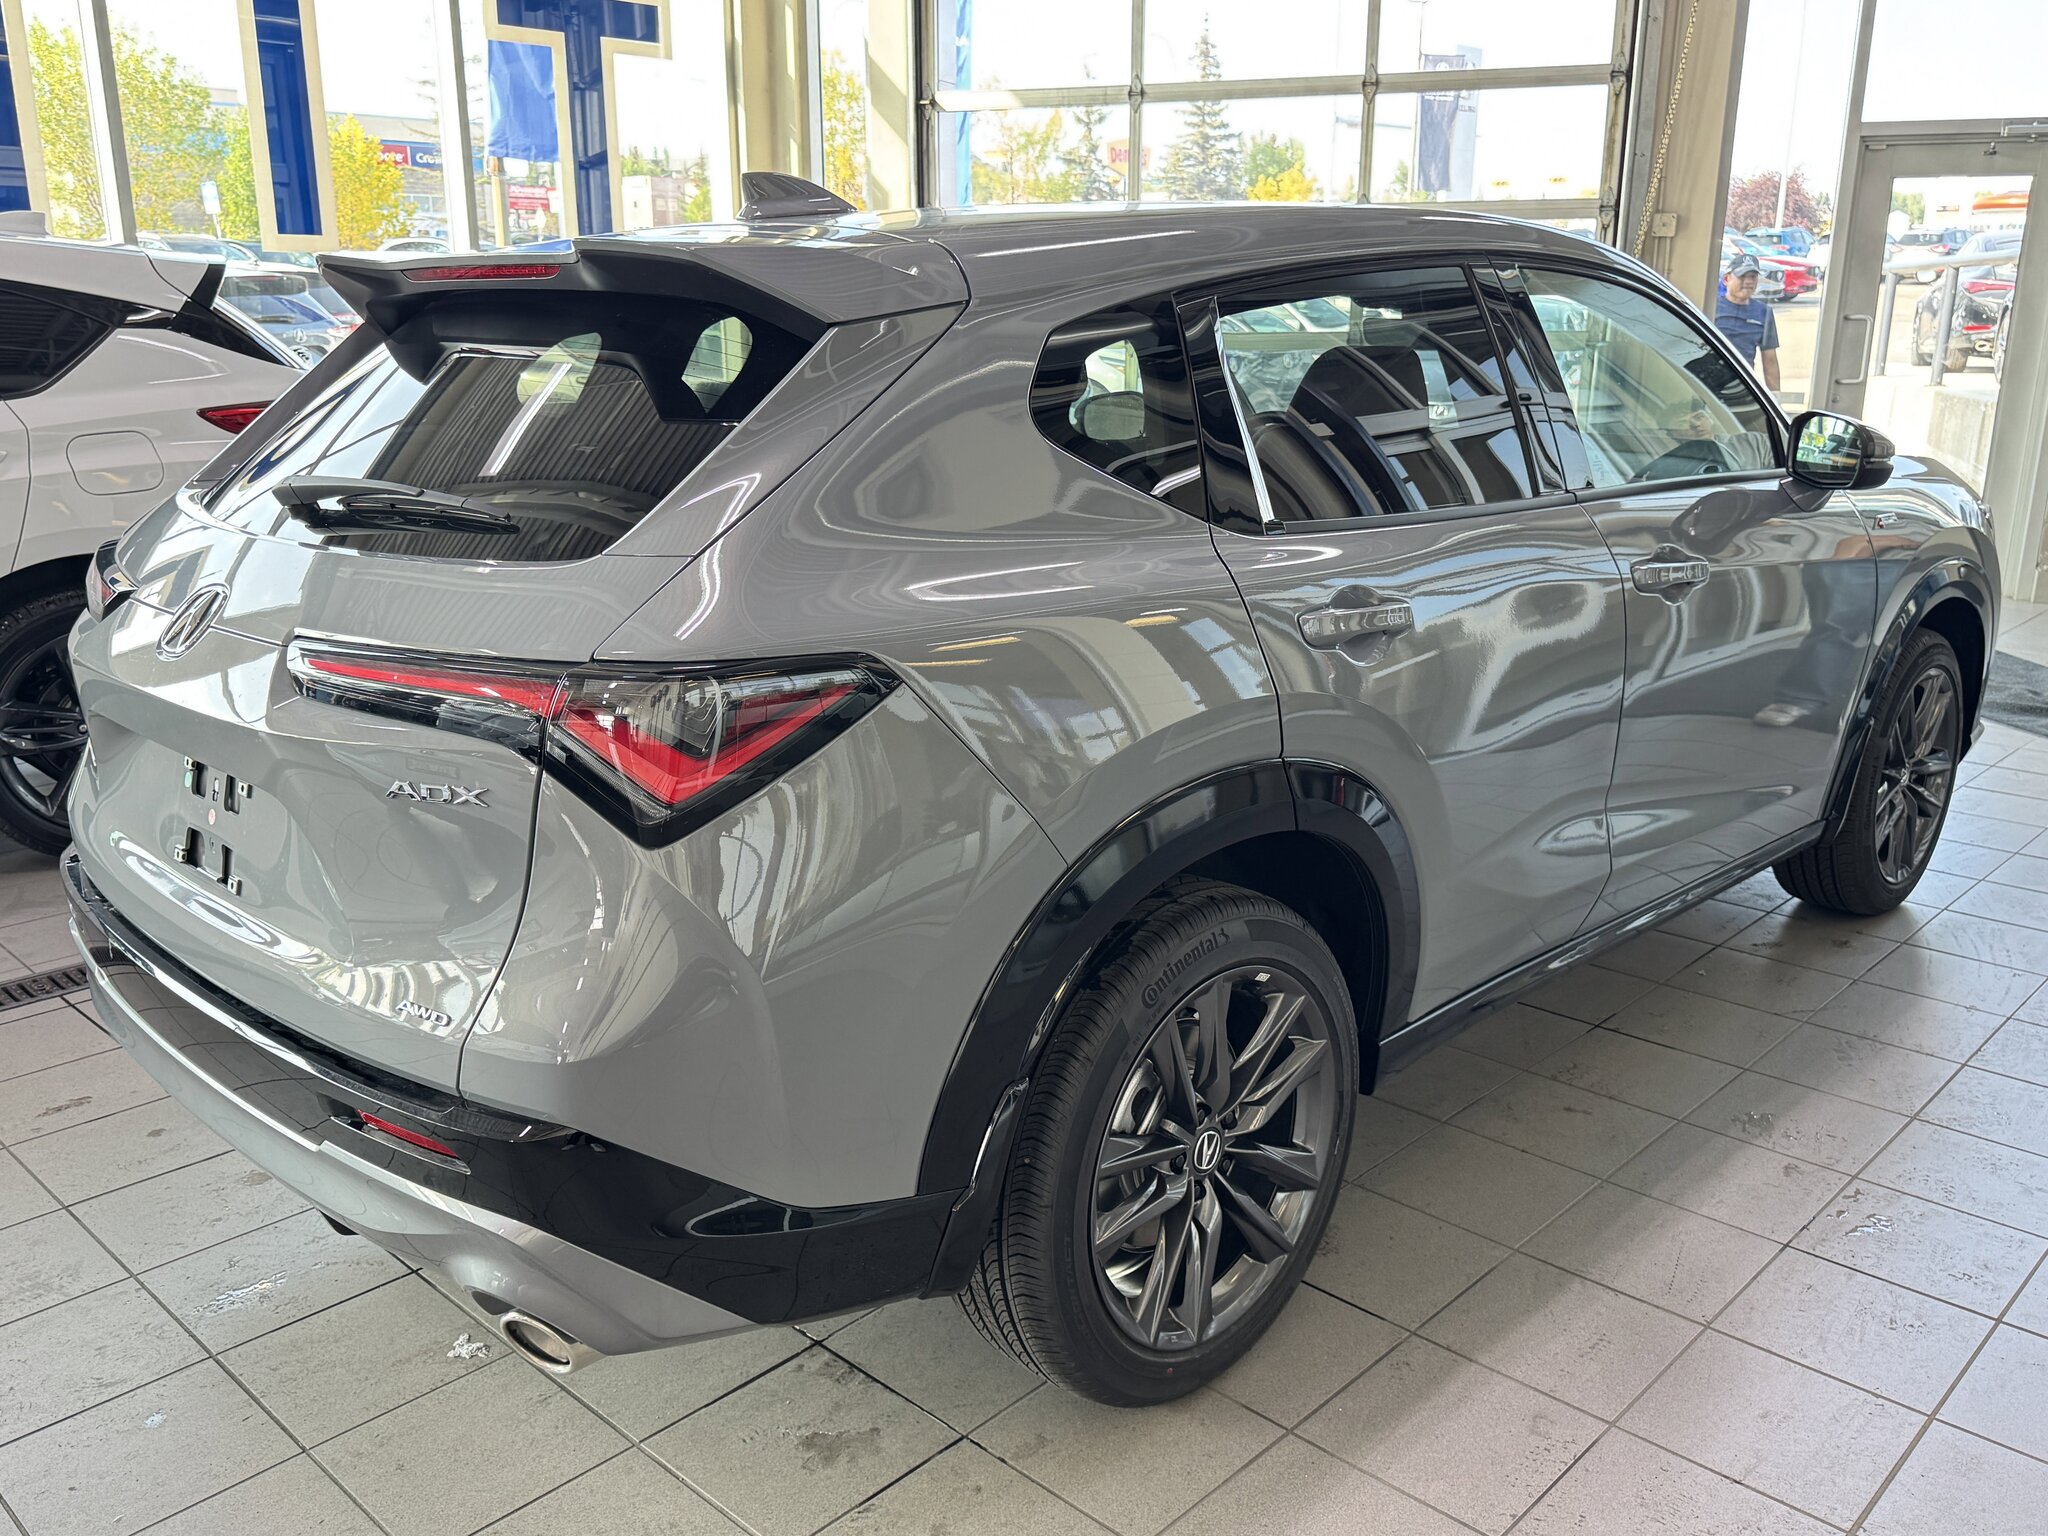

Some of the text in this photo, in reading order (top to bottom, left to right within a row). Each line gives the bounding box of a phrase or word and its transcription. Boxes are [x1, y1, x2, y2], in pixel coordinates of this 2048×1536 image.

[385, 780, 490, 807] ADX
[1141, 931, 1220, 1010] Continental
[395, 999, 452, 1027] AWD
